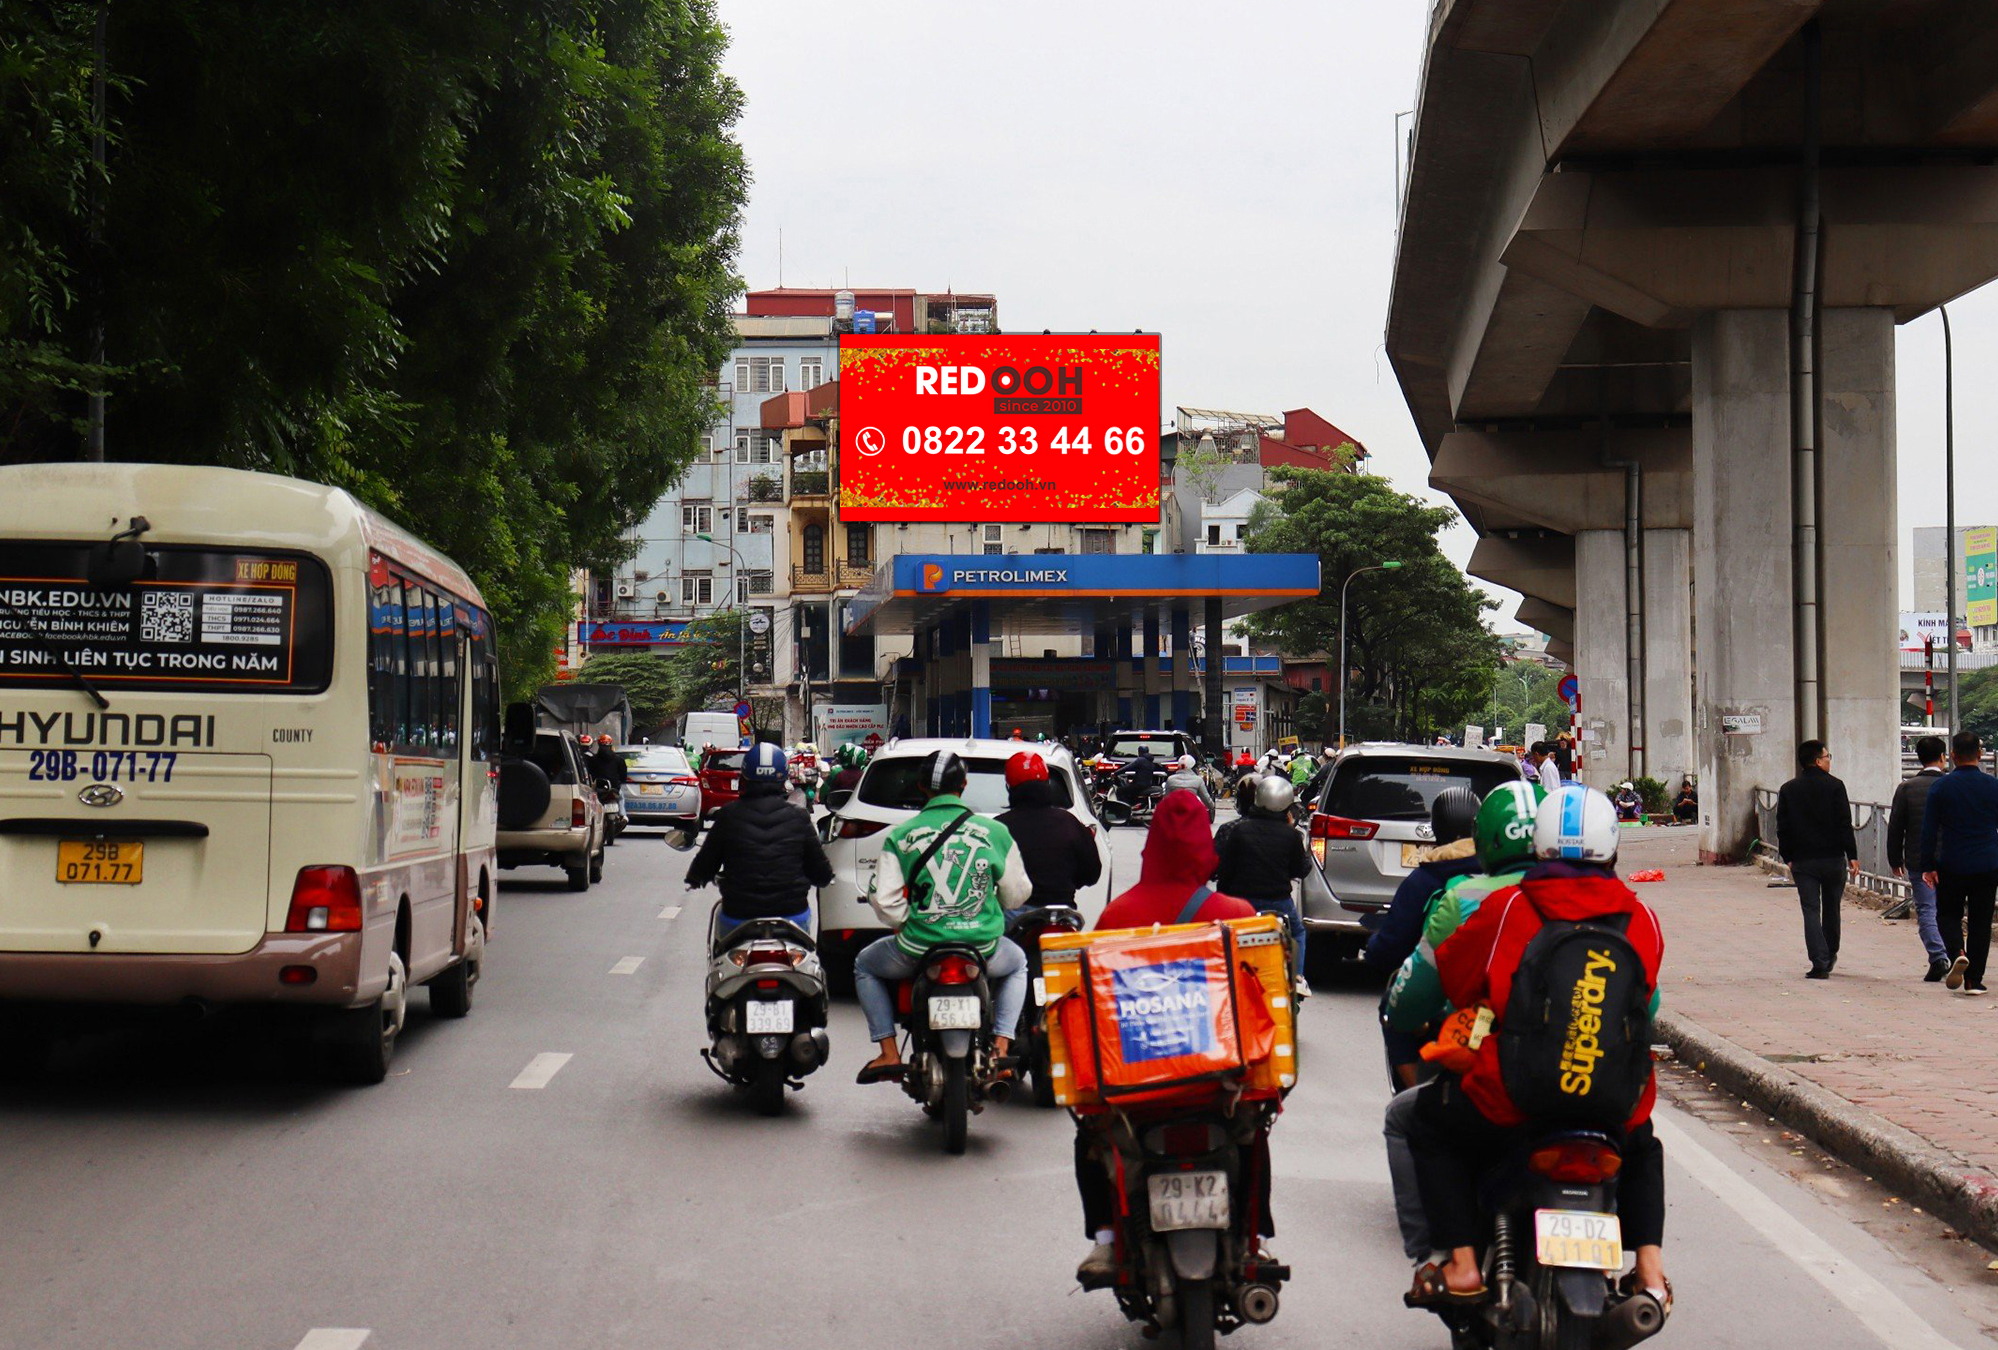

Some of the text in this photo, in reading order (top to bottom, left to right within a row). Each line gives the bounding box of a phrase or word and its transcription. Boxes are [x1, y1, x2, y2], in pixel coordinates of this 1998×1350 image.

[1000, 400, 1077, 412] since 2010
[902, 426, 1145, 455] 0822 33 44 66
[943, 479, 1056, 491] www.redooh.vn
[238, 562, 248, 579] XE
[953, 570, 1068, 583] PETROLIMEX
[209, 596, 275, 604] HOTLINE/ZALO
[87, 620, 130, 632] KHIÊM
[1918, 618, 1936, 627] KÍNH
[64, 648, 107, 666] LIÊN
[113, 652, 152, 670] TỤC
[157, 652, 226, 669] TRONG
[232, 652, 278, 671] NĂM
[0, 711, 214, 747] HYUNDAI
[273, 728, 313, 743] COUNTY
[29, 750, 177, 783] 29B-071-77
[756, 766, 776, 775] DTP
[83, 844, 119, 861] 29B
[67, 863, 133, 880] 071.77
[1119, 990, 1206, 1018] HOSANA
